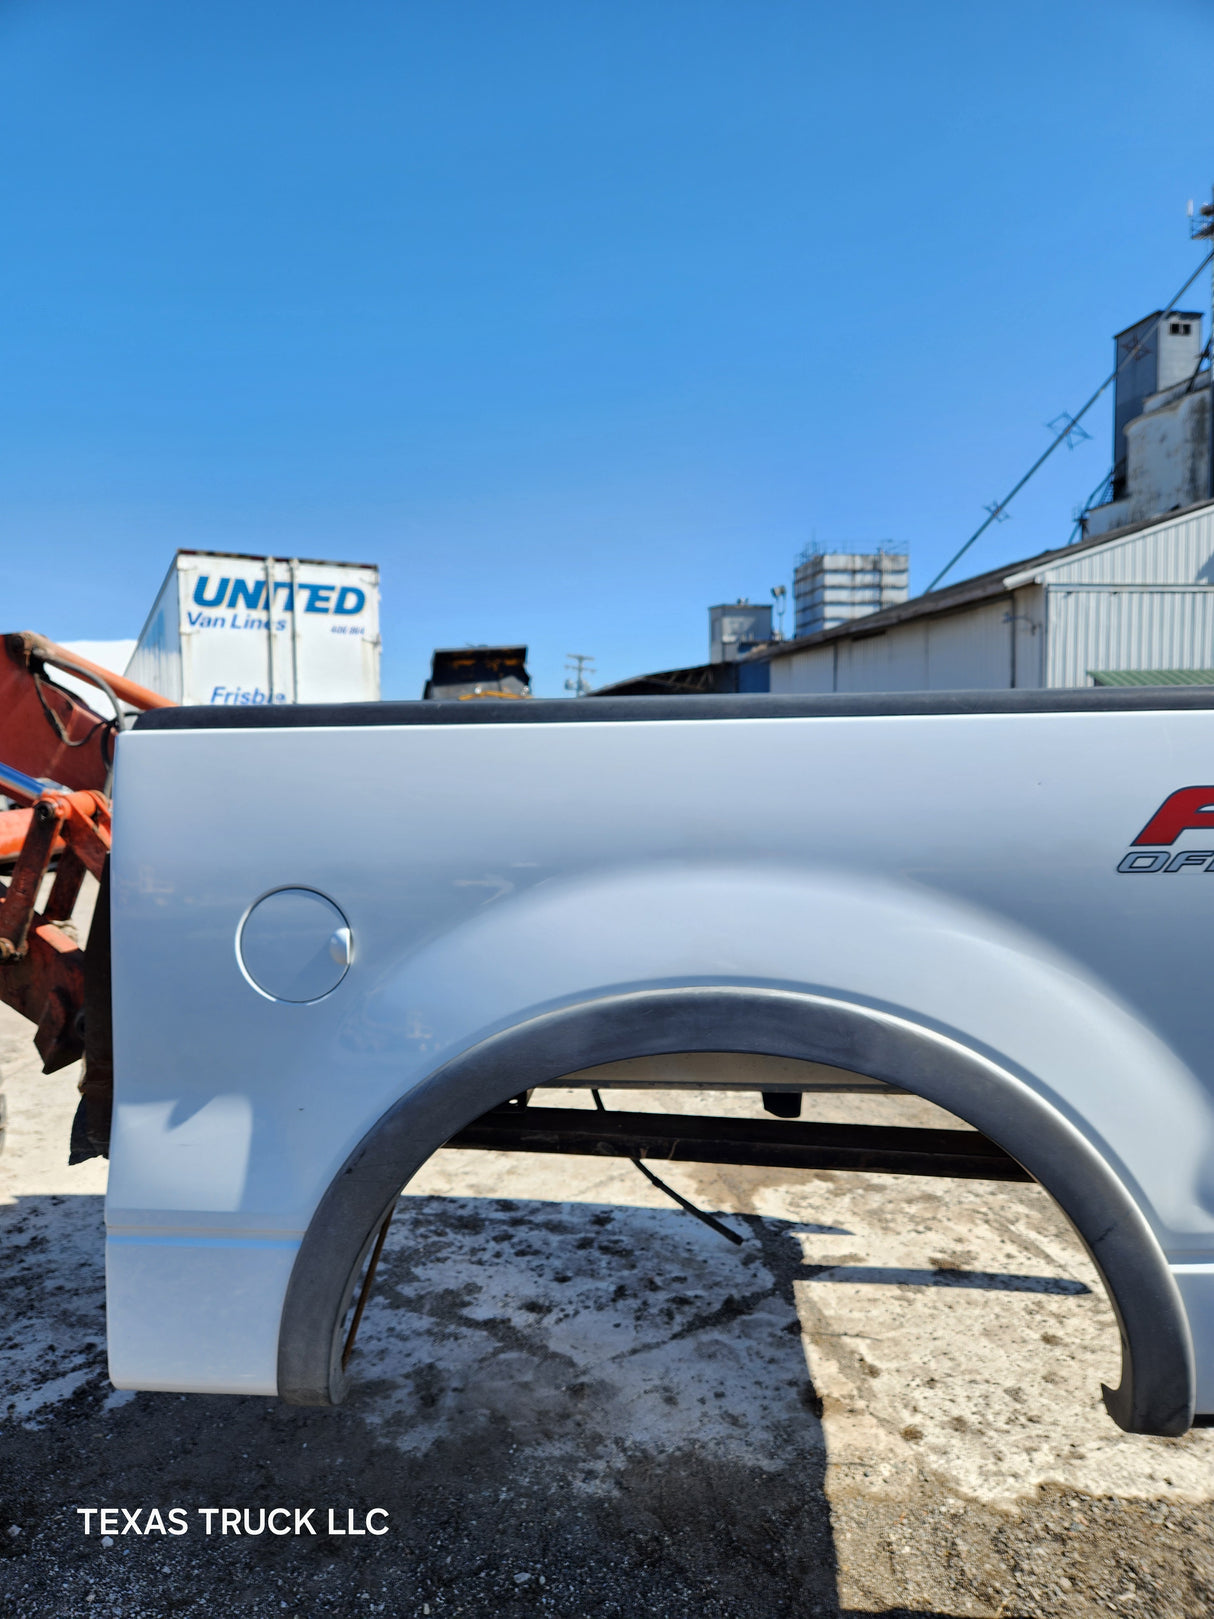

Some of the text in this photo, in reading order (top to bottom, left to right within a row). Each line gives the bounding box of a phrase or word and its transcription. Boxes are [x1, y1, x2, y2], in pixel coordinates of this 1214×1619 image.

[193, 576, 366, 615] UNITED
[187, 611, 226, 629] Van
[1116, 850, 1214, 873] OF
